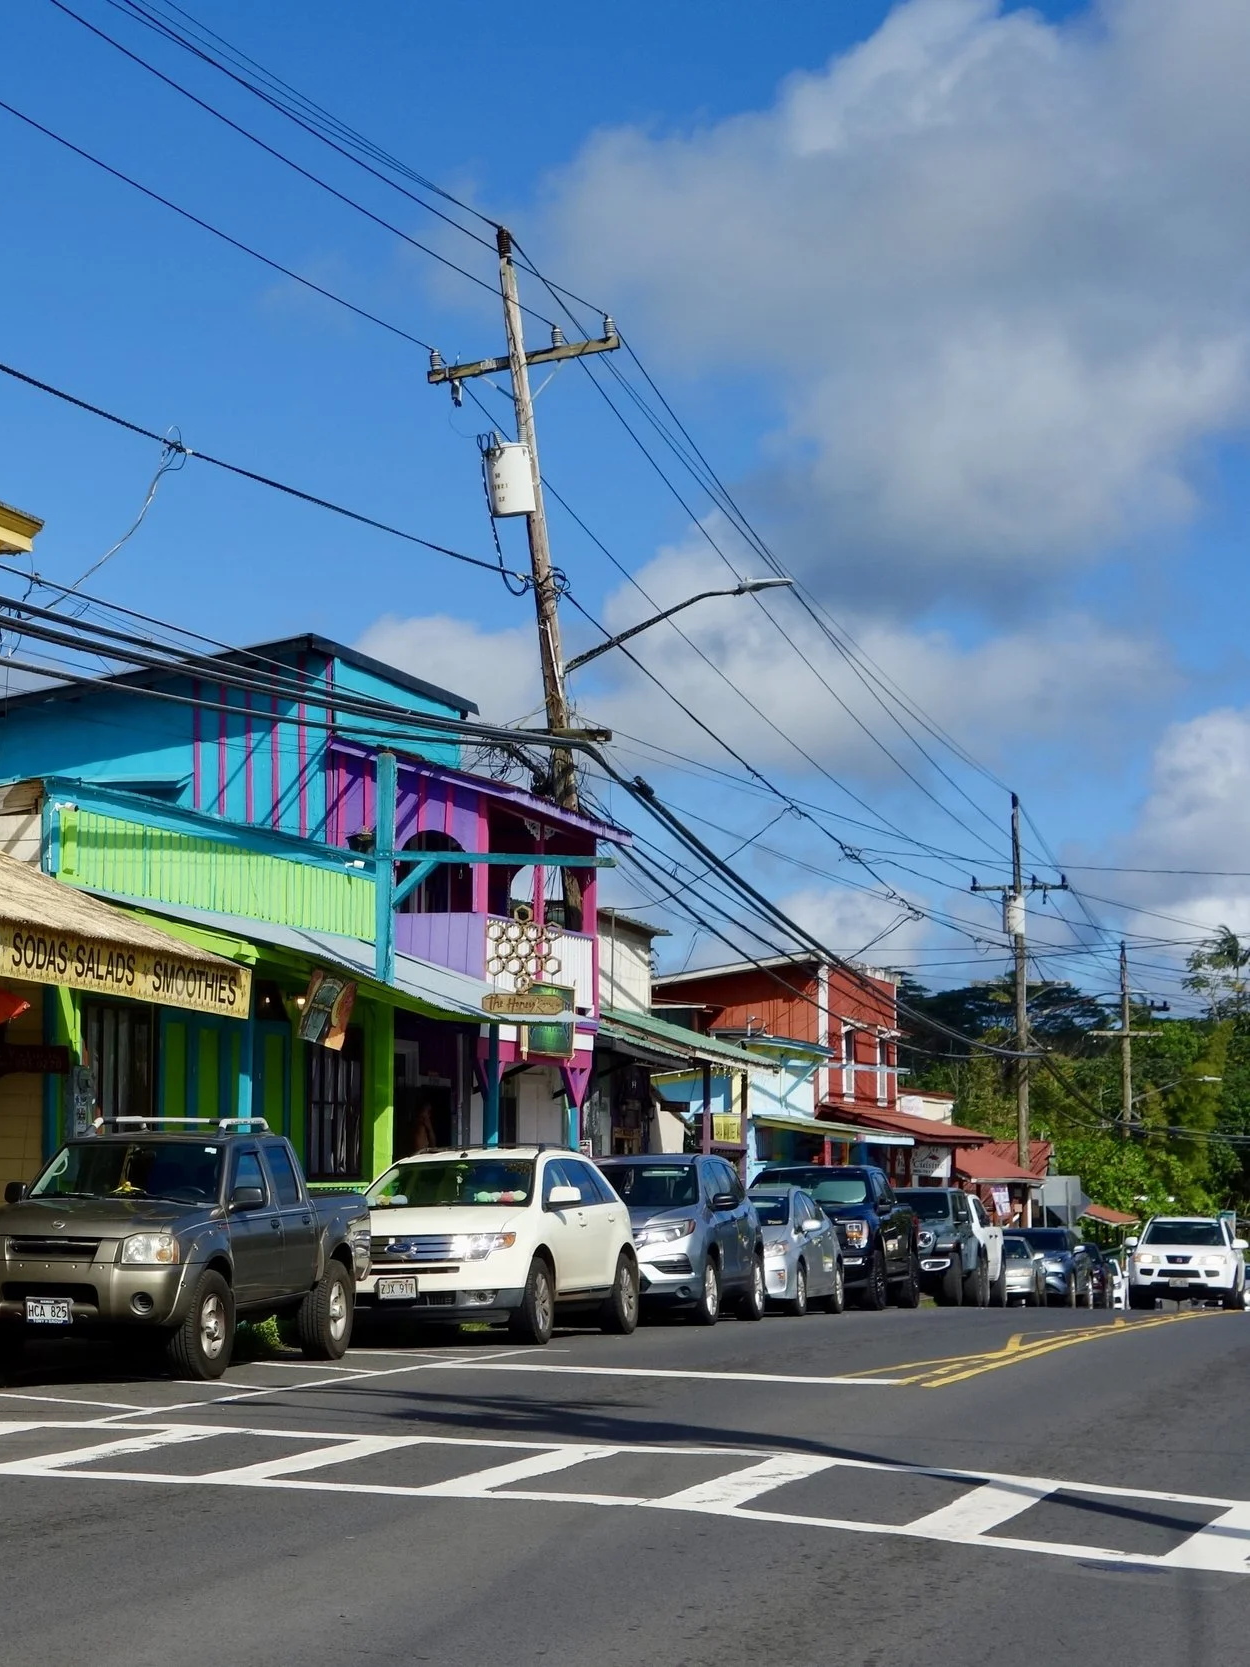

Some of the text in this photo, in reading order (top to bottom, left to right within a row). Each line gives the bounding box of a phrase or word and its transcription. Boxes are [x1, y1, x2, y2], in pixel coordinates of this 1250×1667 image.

[12, 932, 68, 975] SODAS
[74, 944, 136, 987] SALADS
[152, 960, 237, 1006] SMOOTHIES
[28, 1305, 67, 1319] HCA 825
